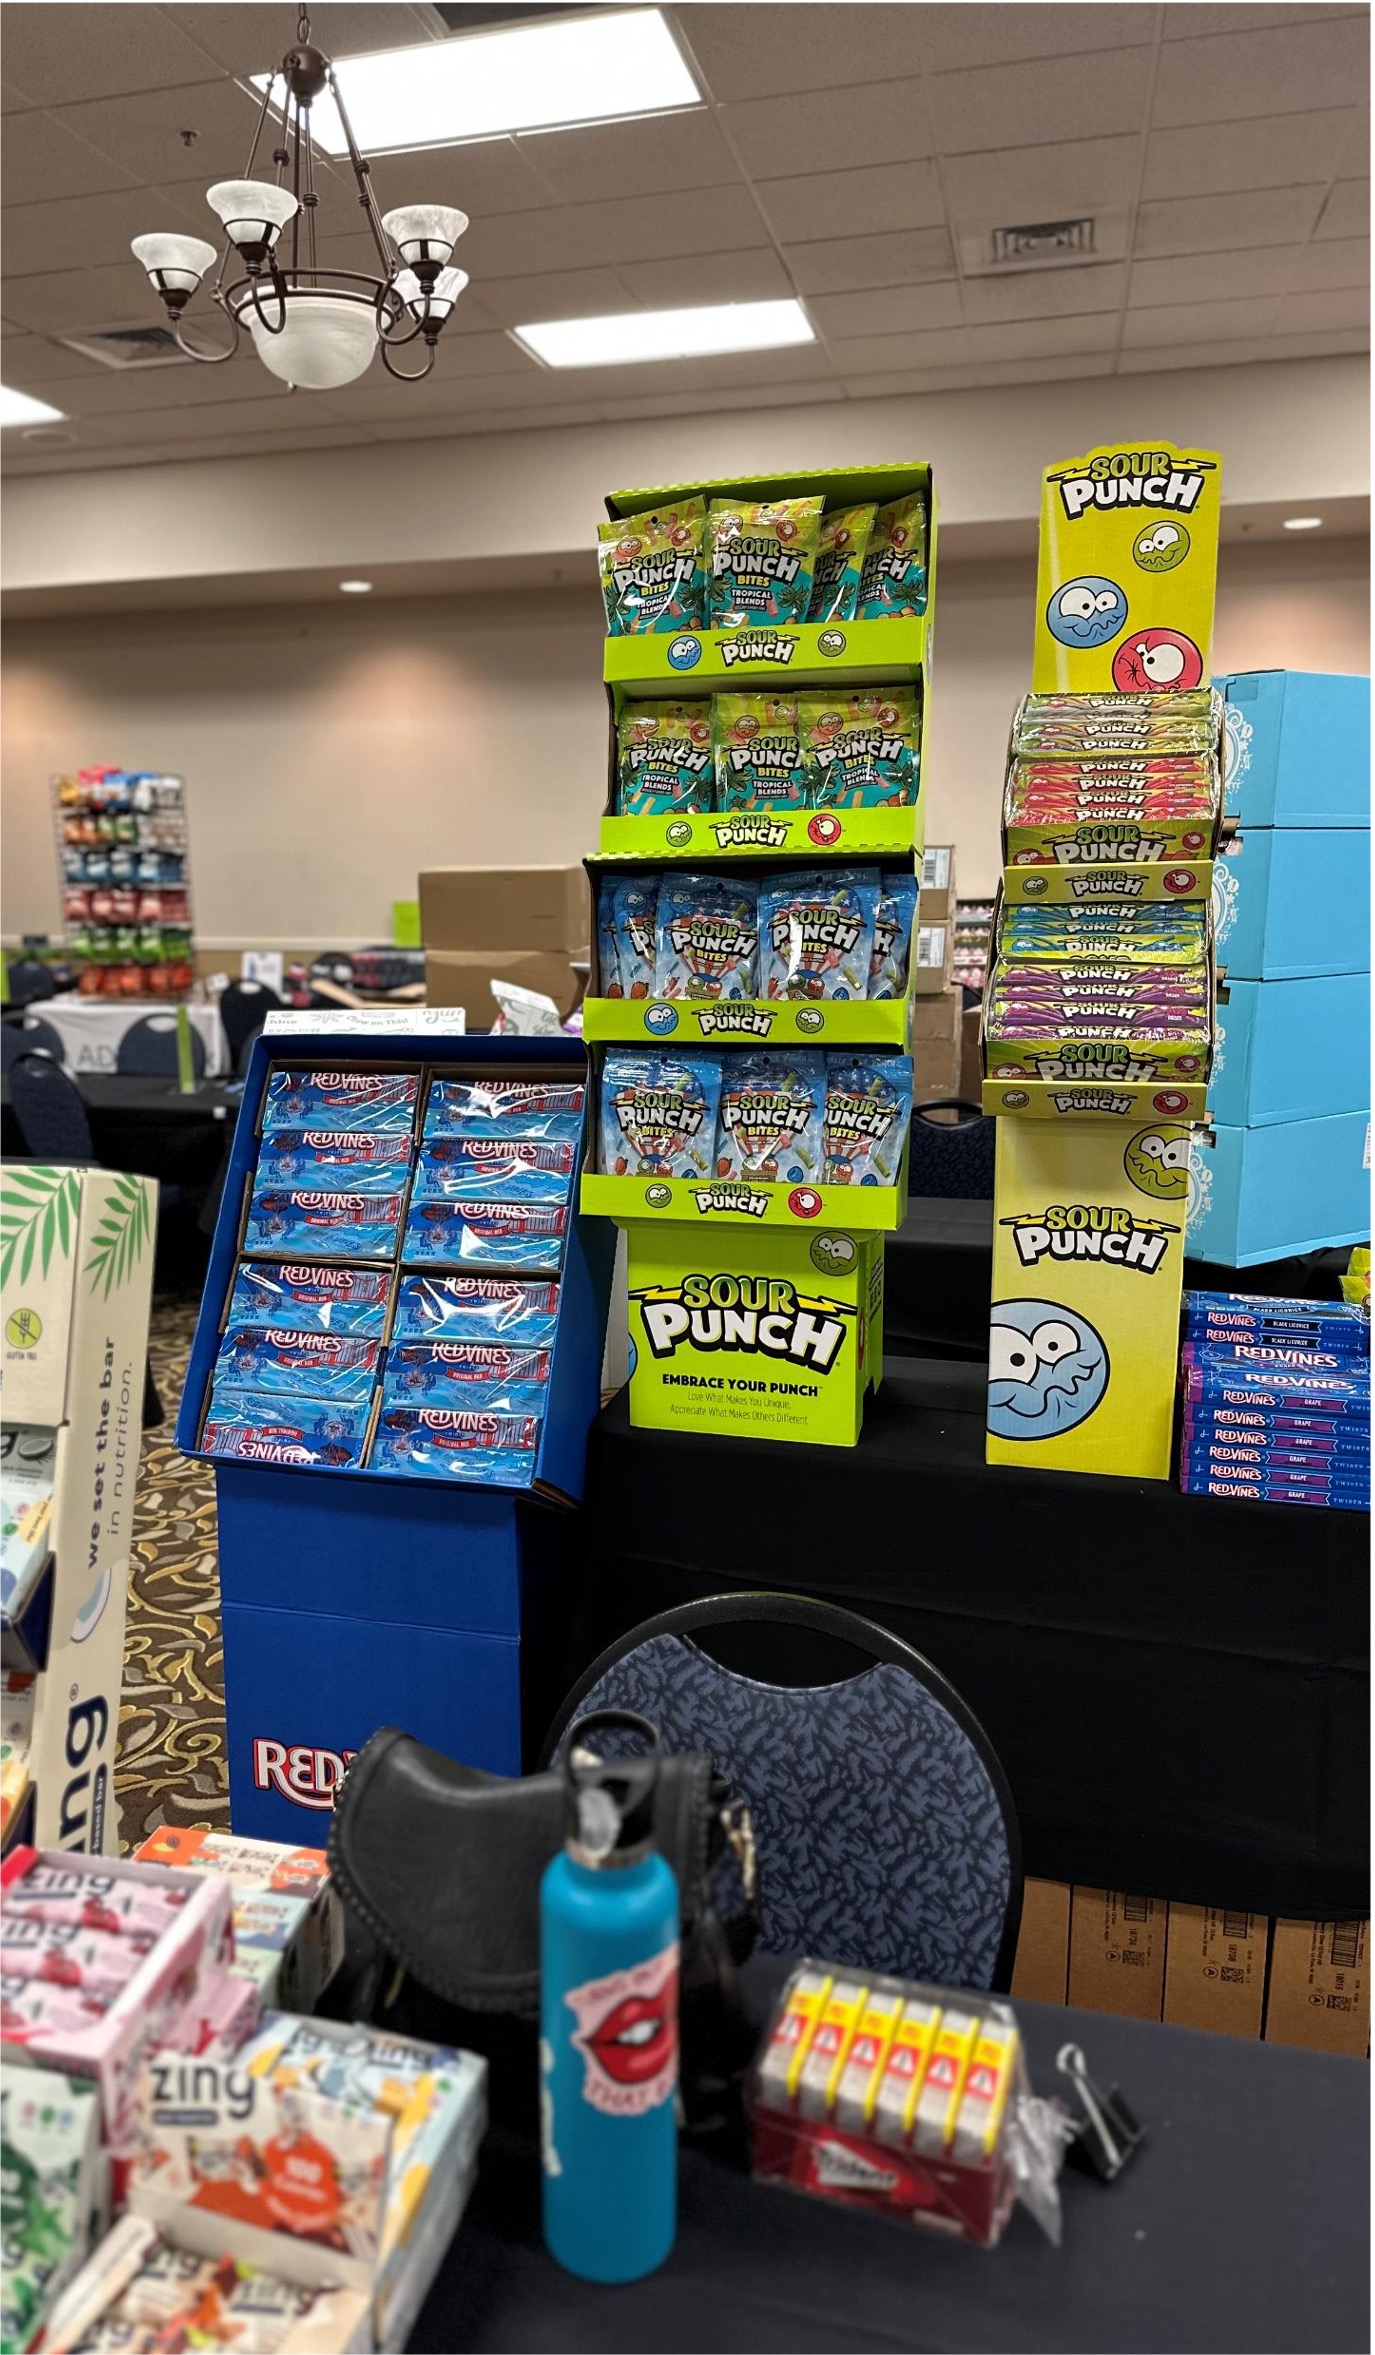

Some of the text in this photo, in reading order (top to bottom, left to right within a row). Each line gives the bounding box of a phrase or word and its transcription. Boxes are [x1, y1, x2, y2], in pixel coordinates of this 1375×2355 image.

[1091, 453, 1170, 481] SOUR
[1061, 471, 1204, 515] PUNCH
[731, 537, 780, 556] SOUR
[631, 549, 676, 572] SOUR
[714, 552, 800, 582] PUNCH
[613, 558, 695, 593] PUNCH
[738, 575, 770, 586] BITES
[641, 582, 669, 596] BITES
[731, 590, 772, 598] TROPICAL
[736, 631, 777, 645] SOUR
[722, 641, 794, 664] PUNCH
[1090, 698, 1151, 707] PUNCH
[1087, 723, 1150, 734] PUNCH
[649, 738, 691, 751] SOUR
[750, 738, 798, 751] SOUR
[834, 728, 882, 748] SOUR
[1082, 740, 1148, 749] PUNCH
[630, 749, 710, 770] PUNCH
[733, 751, 801, 769] PUNC
[815, 741, 902, 768] PUNCH
[648, 762, 678, 774] BITES
[844, 756, 876, 768] BITES
[1080, 762, 1147, 771] PUNCH
[758, 767, 790, 778] BITES
[842, 767, 878, 781] TROPICAL
[641, 775, 680, 785] TROPICAL
[643, 781, 672, 791] BLENDS
[752, 780, 792, 789] TROPICAL
[1080, 778, 1147, 790] PUNCH
[757, 788, 787, 796] BLENDS
[1077, 794, 1146, 805] PUNCH
[1075, 810, 1145, 820] PUNCH
[731, 816, 770, 830] SOUR
[715, 825, 787, 847] PUNCH
[1076, 826, 1140, 844] SOUR
[1054, 841, 1166, 863] PUNCH
[1086, 871, 1127, 882] SOUR
[1072, 879, 1143, 896] PUNCH
[1069, 907, 1138, 918] PUNCH
[690, 923, 740, 939] SOUR
[1066, 923, 1137, 933] PUNCH
[772, 925, 859, 949] PNCH
[1078, 936, 1121, 944] SOUR
[672, 932, 758, 957] PUNCH
[798, 942, 826, 954] ITES
[1066, 941, 1135, 951] PUNCH
[696, 949, 727, 962] BITES
[1061, 969, 1131, 981] PUNCH
[1063, 986, 1135, 998] PUNCH
[713, 1004, 755, 1018] SOUR
[1063, 1005, 1136, 1019] PUNCH
[700, 1015, 772, 1035] PUNCH
[1061, 1044, 1129, 1063] SOUR
[1037, 1061, 1156, 1082] PUNCH
[634, 1093, 682, 1110] SOUR
[1070, 1089, 1112, 1100] SOUR
[740, 1094, 788, 1110] SOUR
[828, 1095, 877, 1115] SOUR
[1055, 1097, 1132, 1114] PUNCH
[619, 1106, 703, 1133] PUNCH
[721, 1108, 809, 1132] PUNCH
[642, 1126, 673, 1138] BITES
[748, 1126, 779, 1136] BITES
[830, 1127, 860, 1140] BITES
[710, 1184, 750, 1198] SOUR
[699, 1193, 767, 1216] PUNCH
[1046, 1206, 1131, 1231] SOUR
[1016, 1227, 1167, 1269] PUNCH
[683, 1276, 795, 1314] SOUR
[644, 1303, 843, 1365] PUNCH
[662, 1374, 818, 1397] EMBRACE YOUR PUNCH
[688, 1392, 703, 1400] Love
[705, 1393, 723, 1403] What
[726, 1395, 747, 1405] Makes
[749, 1397, 761, 1406] You
[670, 1404, 706, 1415] Appreciate
[708, 1407, 727, 1418] What
[729, 1409, 750, 1419] Makes
[752, 1411, 775, 1422] Others
[1293, 1419, 1311, 1427] GRAPE
[107, 1362, 132, 1535] in nutrition.
[1295, 1438, 1313, 1446] GRAPE
[88, 1337, 115, 1569] we set the bar
[1289, 1455, 1306, 1463] GRAPE
[1288, 1491, 1305, 1499] GRAPE
[151, 2065, 255, 2119] zing
